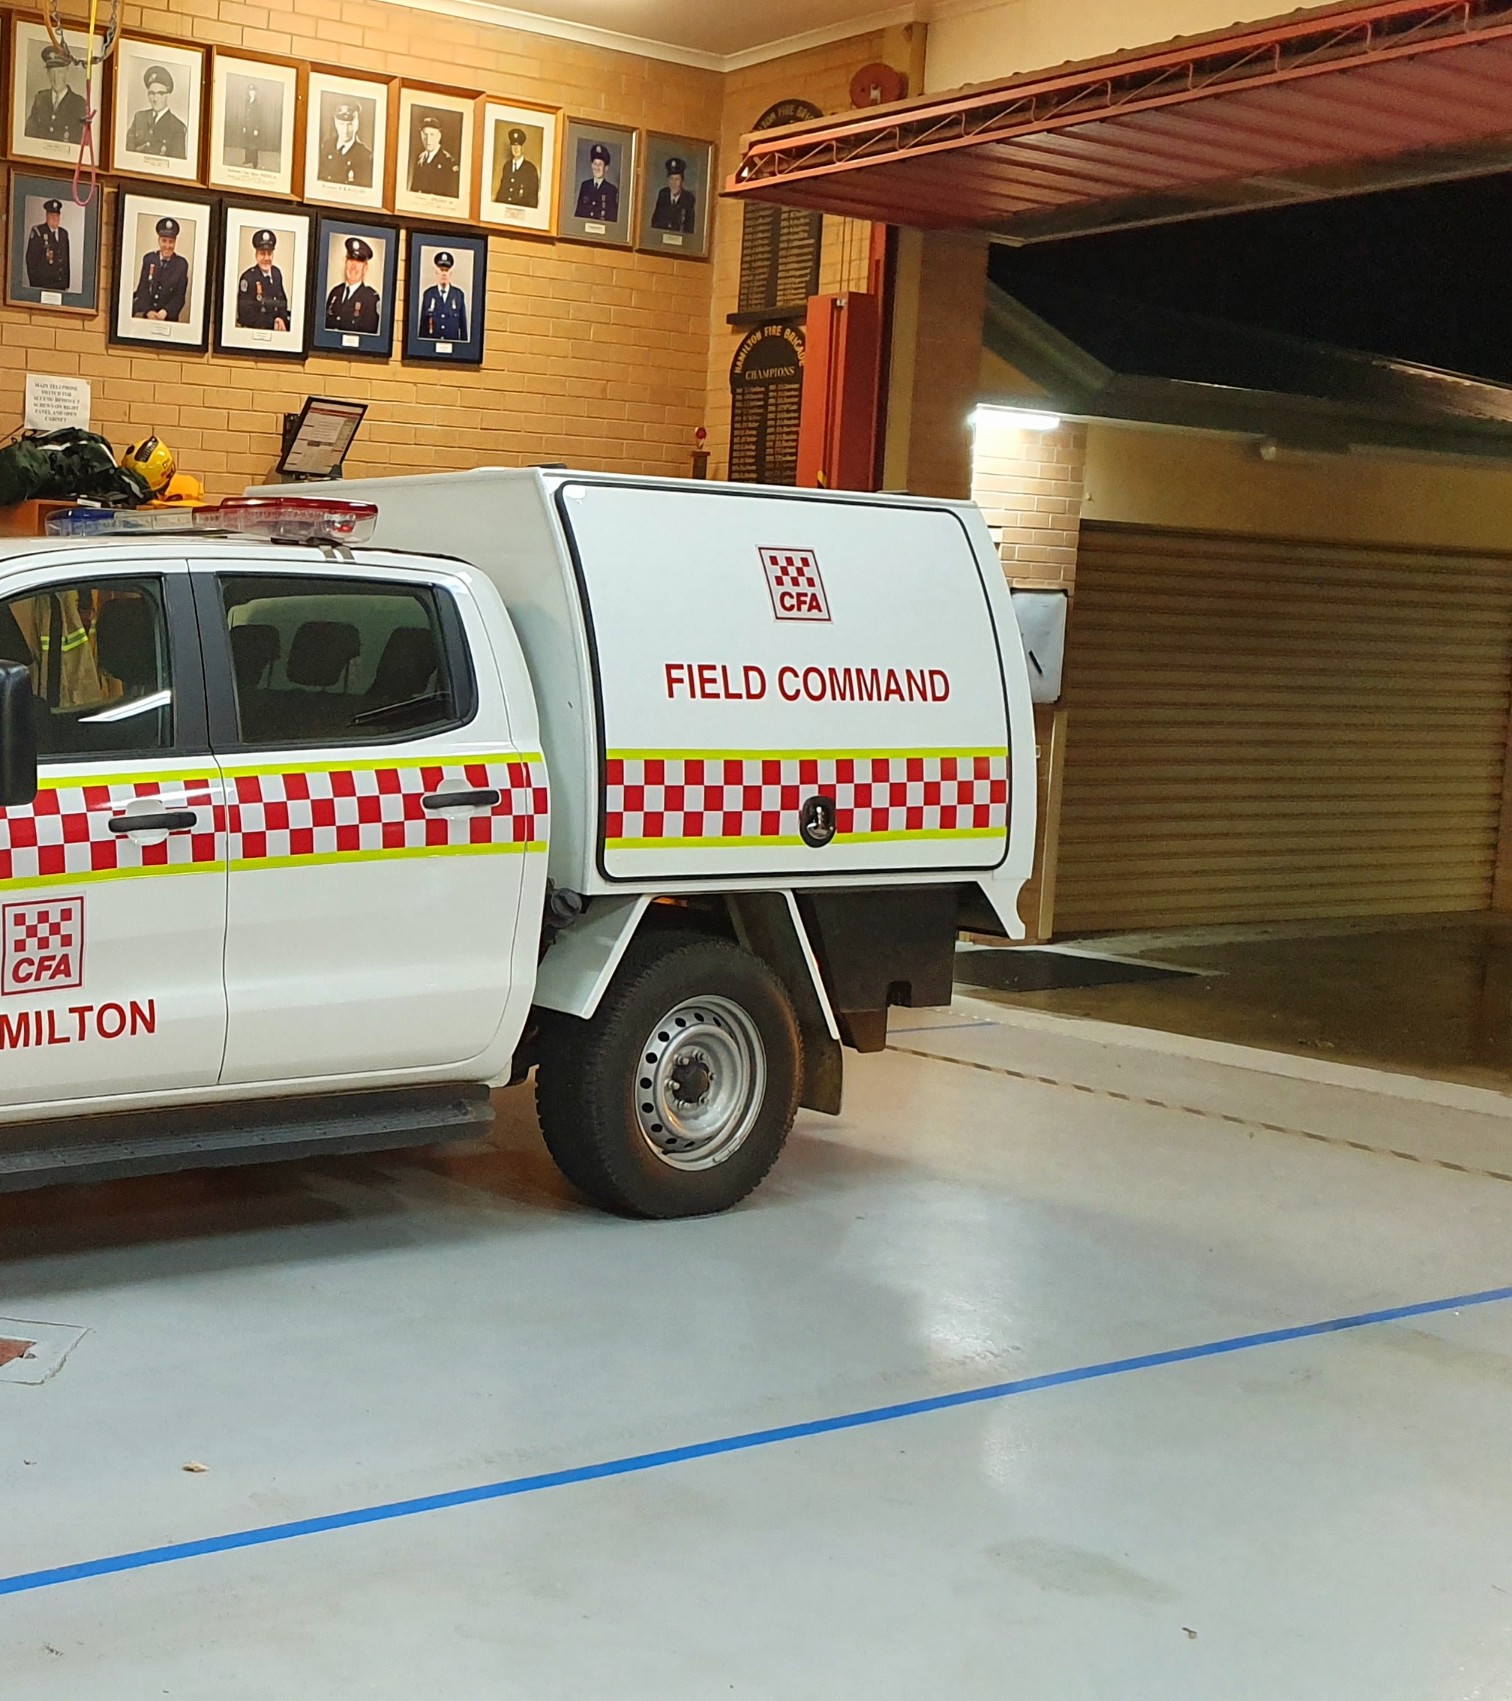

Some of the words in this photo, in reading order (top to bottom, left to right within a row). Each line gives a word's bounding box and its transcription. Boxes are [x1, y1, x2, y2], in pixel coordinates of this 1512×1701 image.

[734, 330, 762, 373] HAMILTON
[764, 325, 783, 337] FIRE
[745, 366, 796, 380] CHAMPIONS
[778, 590, 823, 613] CFA
[664, 663, 767, 700] FIELD
[777, 665, 950, 702] COMMAND
[11, 953, 72, 984] CFA
